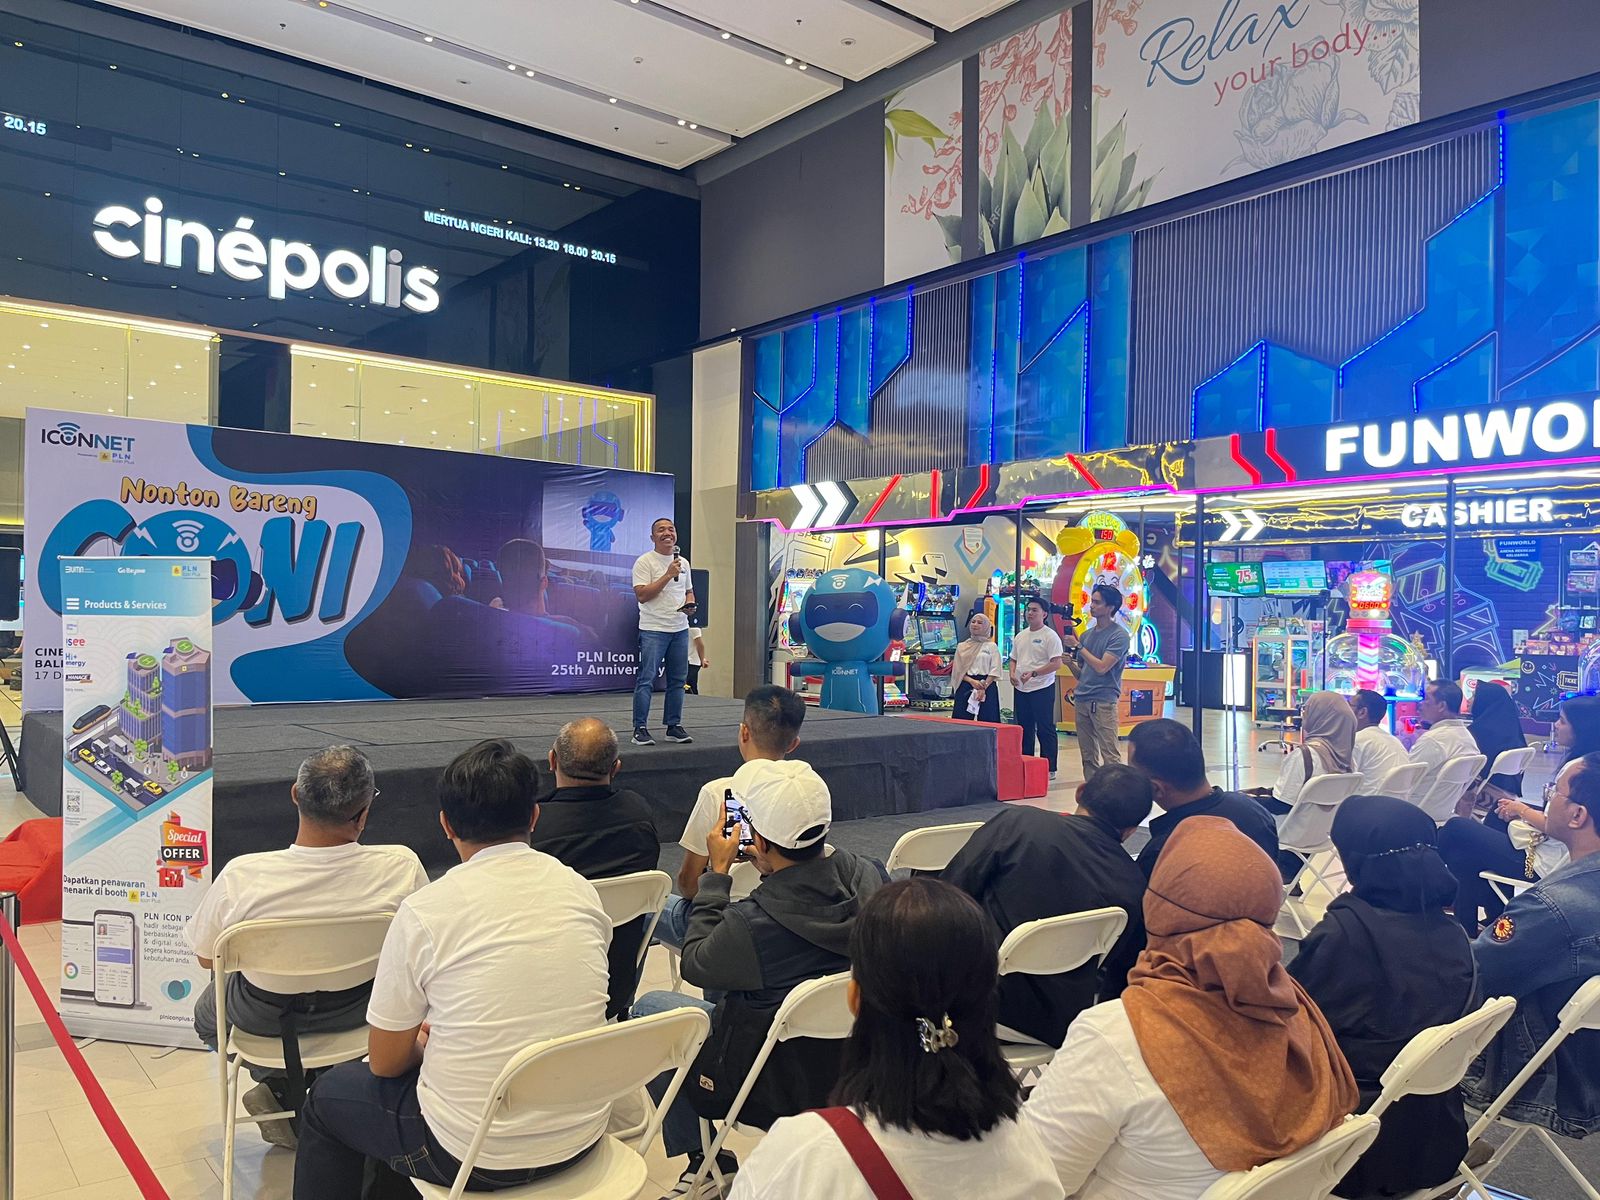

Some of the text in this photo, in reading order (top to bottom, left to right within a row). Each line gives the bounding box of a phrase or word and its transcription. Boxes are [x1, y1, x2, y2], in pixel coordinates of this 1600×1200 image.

[1140, 0, 1310, 88] Relax
[1213, 55, 1282, 107] your
[4, 116, 47, 135] 20.15
[424, 211, 470, 231] MERTUA
[471, 222, 504, 239] NGERI
[505, 230, 532, 245] KALI:
[563, 243, 589, 258] 18.00
[591, 249, 617, 264] 20.15
[92, 196, 440, 314] cinépolis
[41, 427, 135, 452] ICONNET
[120, 476, 318, 521] Nonton Bareng
[1400, 497, 1555, 528] CASHIER
[84, 599, 167, 610] Products & Services
[577, 652, 603, 662] PLN
[607, 652, 635, 662] Icon
[35, 671, 63, 680] 17 D
[551, 664, 665, 677] 25th Annivery
[168, 829, 203, 843] Special
[163, 848, 200, 859] OFFER
[64, 875, 146, 889] Dapatkan penawaran
[64, 886, 158, 898] menarik di booth PLN
[144, 912, 159, 920] PLN
[163, 913, 181, 922] ICON
